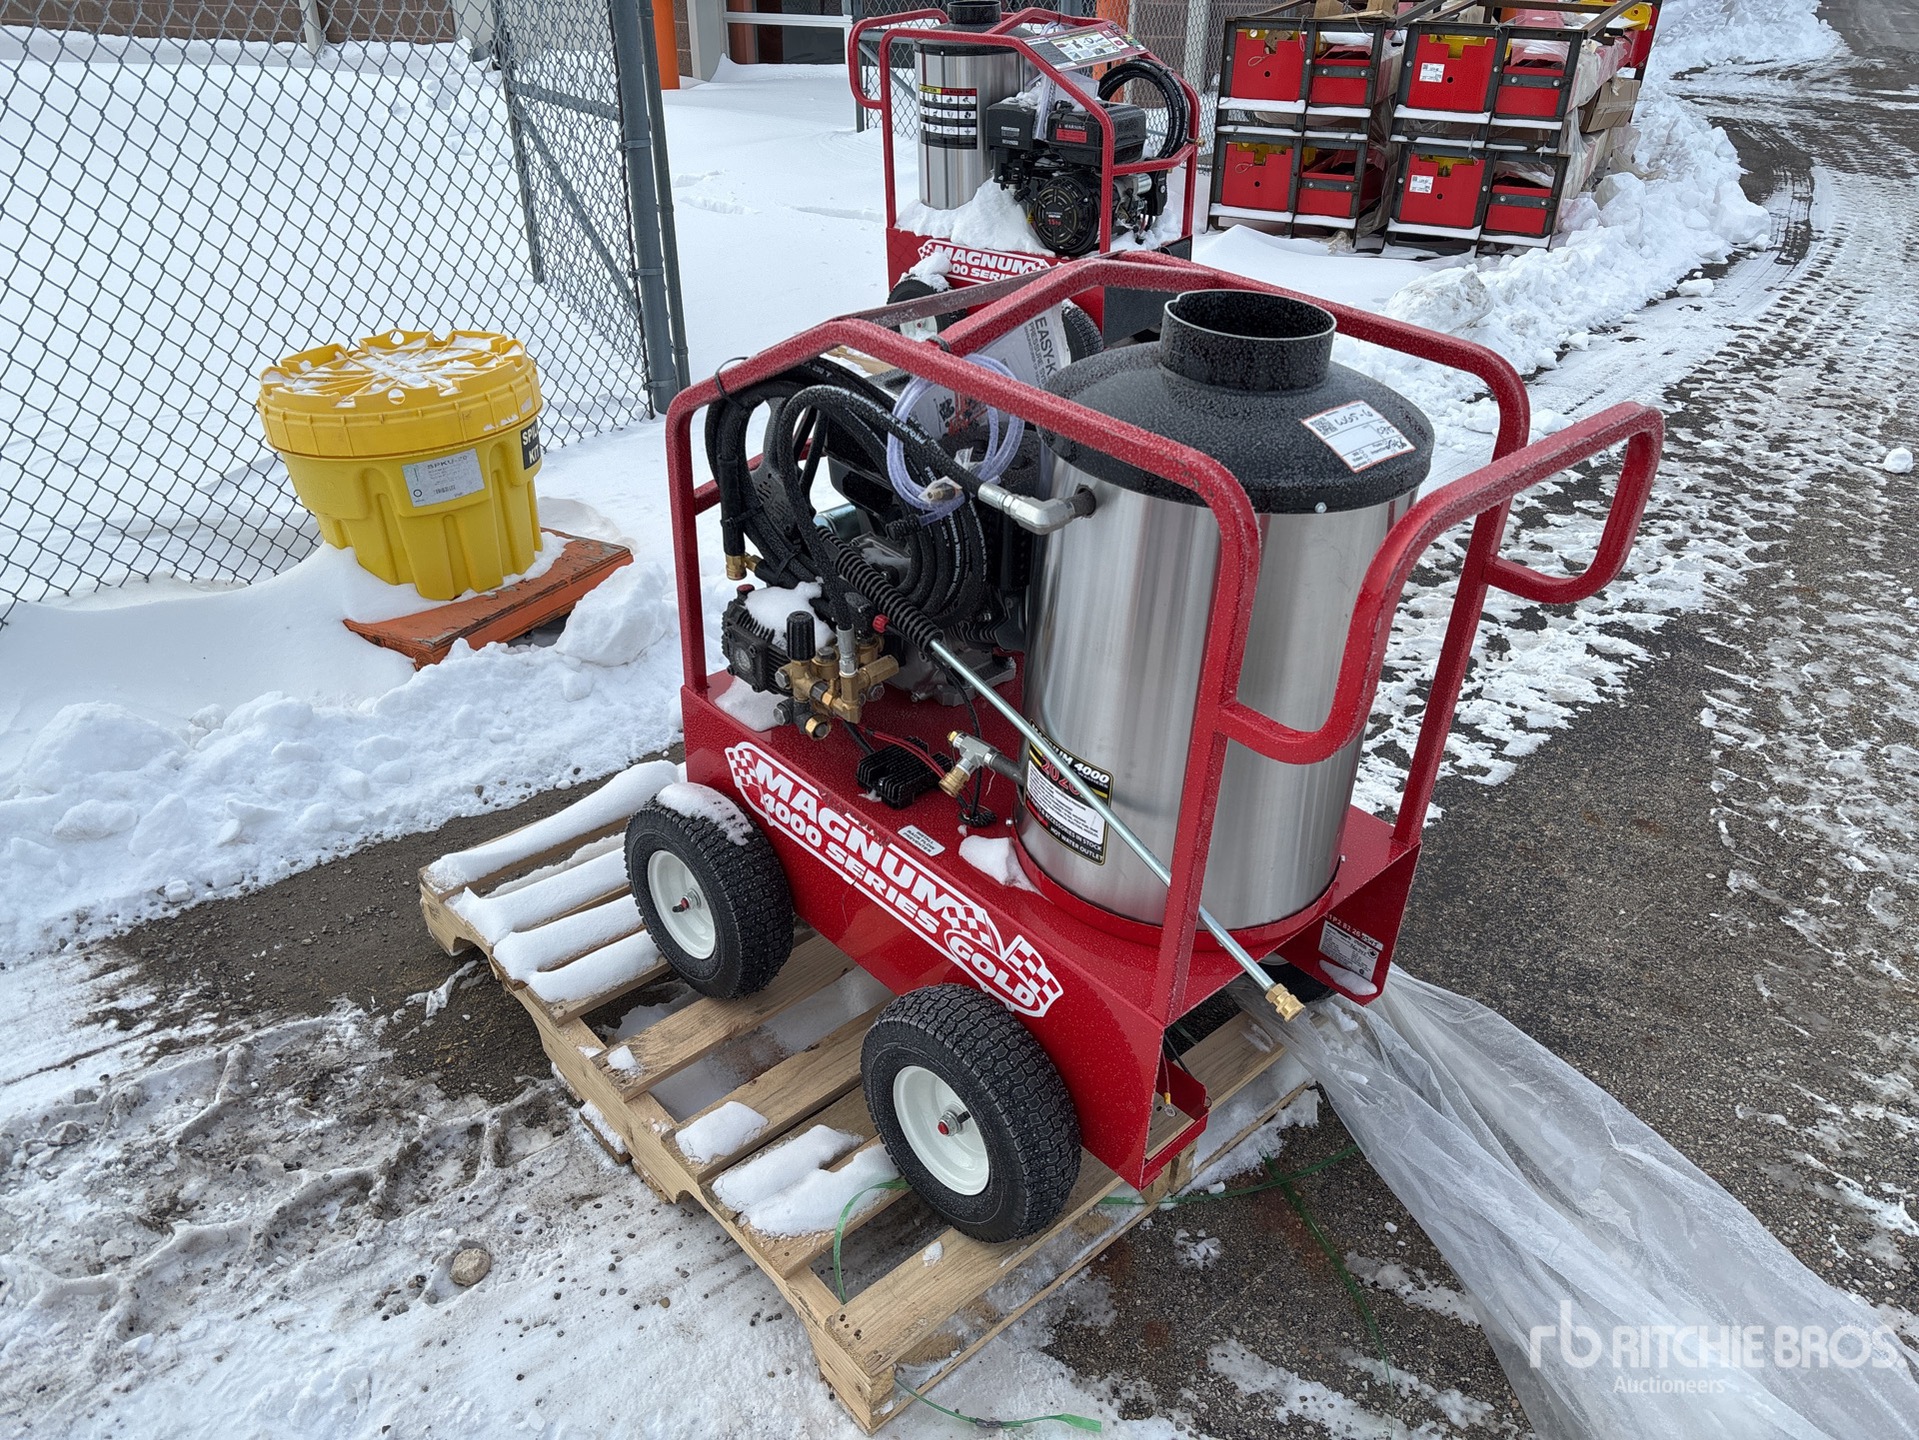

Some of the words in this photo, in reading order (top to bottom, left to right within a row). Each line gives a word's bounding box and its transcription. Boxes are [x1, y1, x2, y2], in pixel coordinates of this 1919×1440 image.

[952, 263, 969, 275] 00
[970, 267, 1012, 281] SERI
[1035, 316, 1057, 375] EASY-K
[1074, 761, 1110, 784] 4000
[754, 759, 950, 913] MAGNUM
[1043, 812, 1076, 838] ACCESSORIES
[1081, 838, 1102, 851] STOCK
[1049, 826, 1061, 837] HOT
[1060, 834, 1080, 849] WATER
[1078, 845, 1103, 860] OUTLET
[763, 793, 822, 850] 4000
[826, 843, 940, 935] SERIES
[950, 935, 1036, 1007] GOLD
